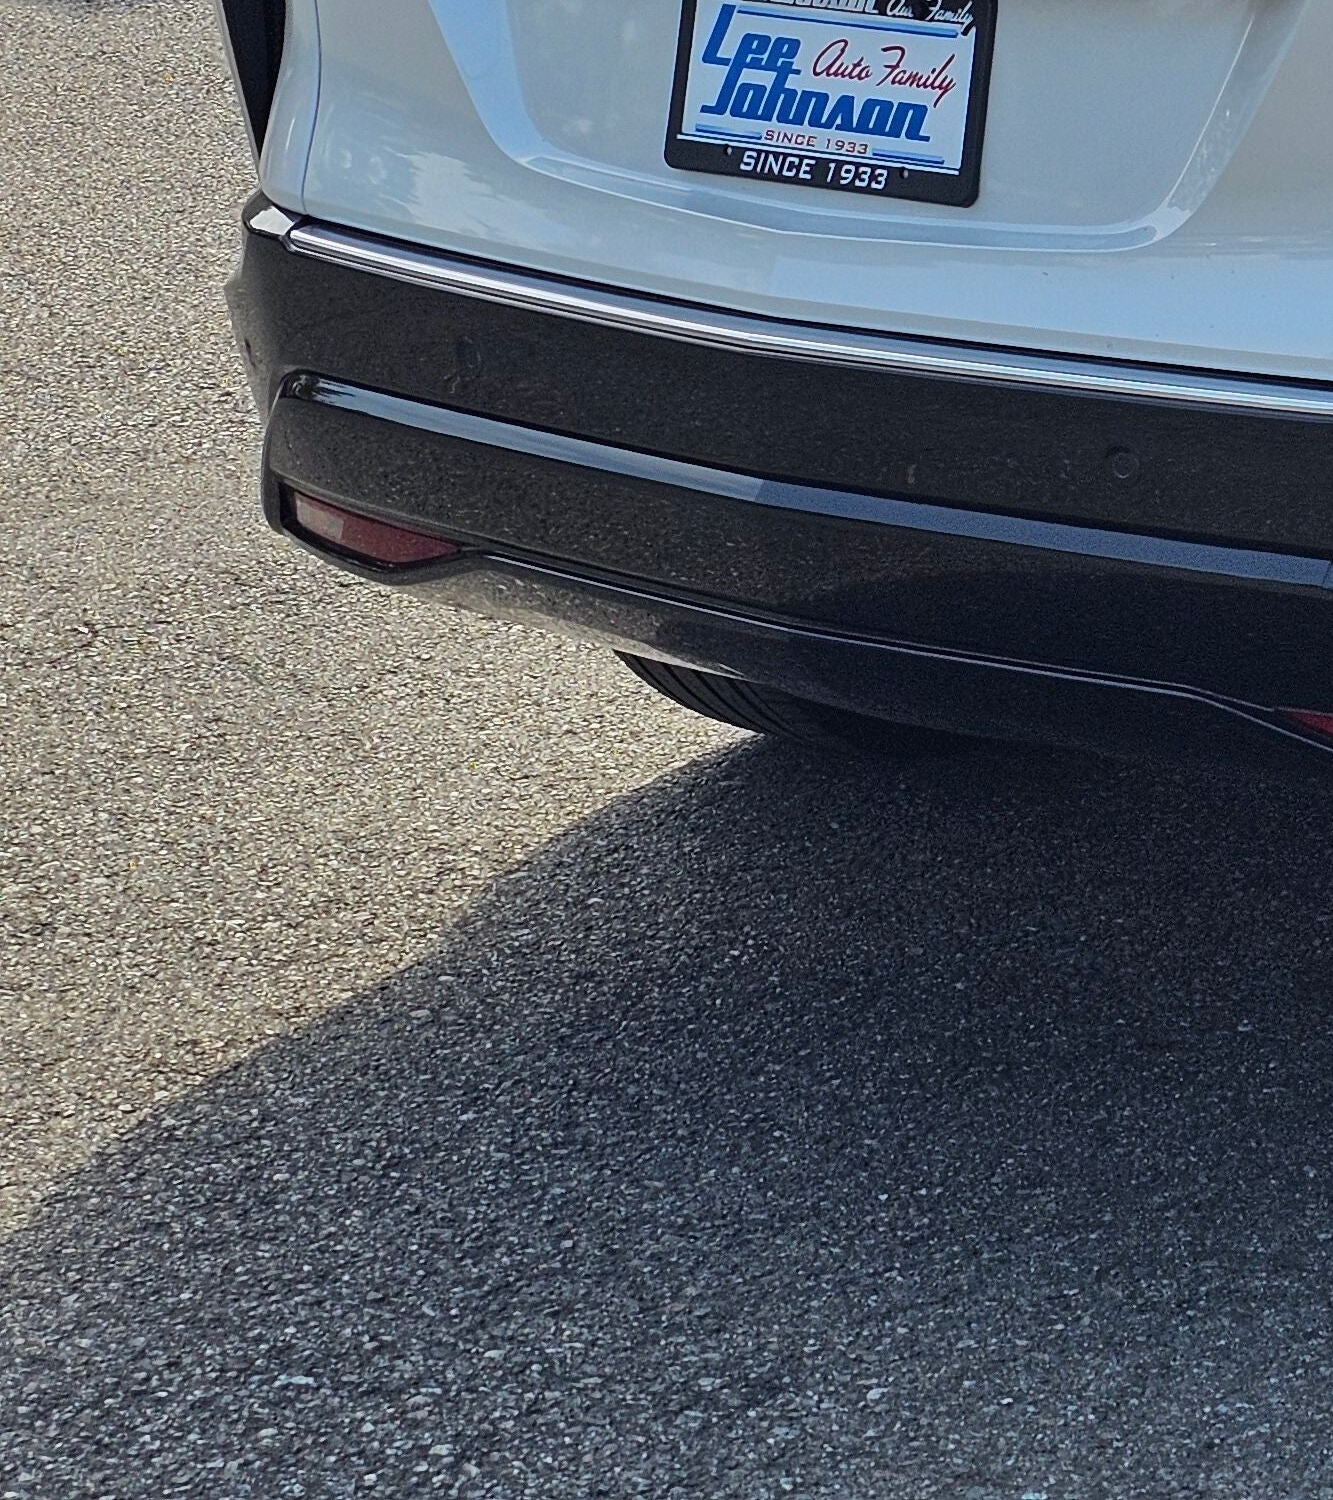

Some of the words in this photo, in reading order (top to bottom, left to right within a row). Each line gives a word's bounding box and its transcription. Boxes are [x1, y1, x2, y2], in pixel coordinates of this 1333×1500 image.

[702, 4, 802, 70] Lee
[700, 62, 931, 142] Johnson
[812, 39, 874, 81] Auto
[876, 45, 957, 108] Family
[740, 150, 815, 180] SINCE
[826, 163, 888, 190] 1933
[763, 130, 816, 148] SINCE
[825, 137, 870, 155] 1933
